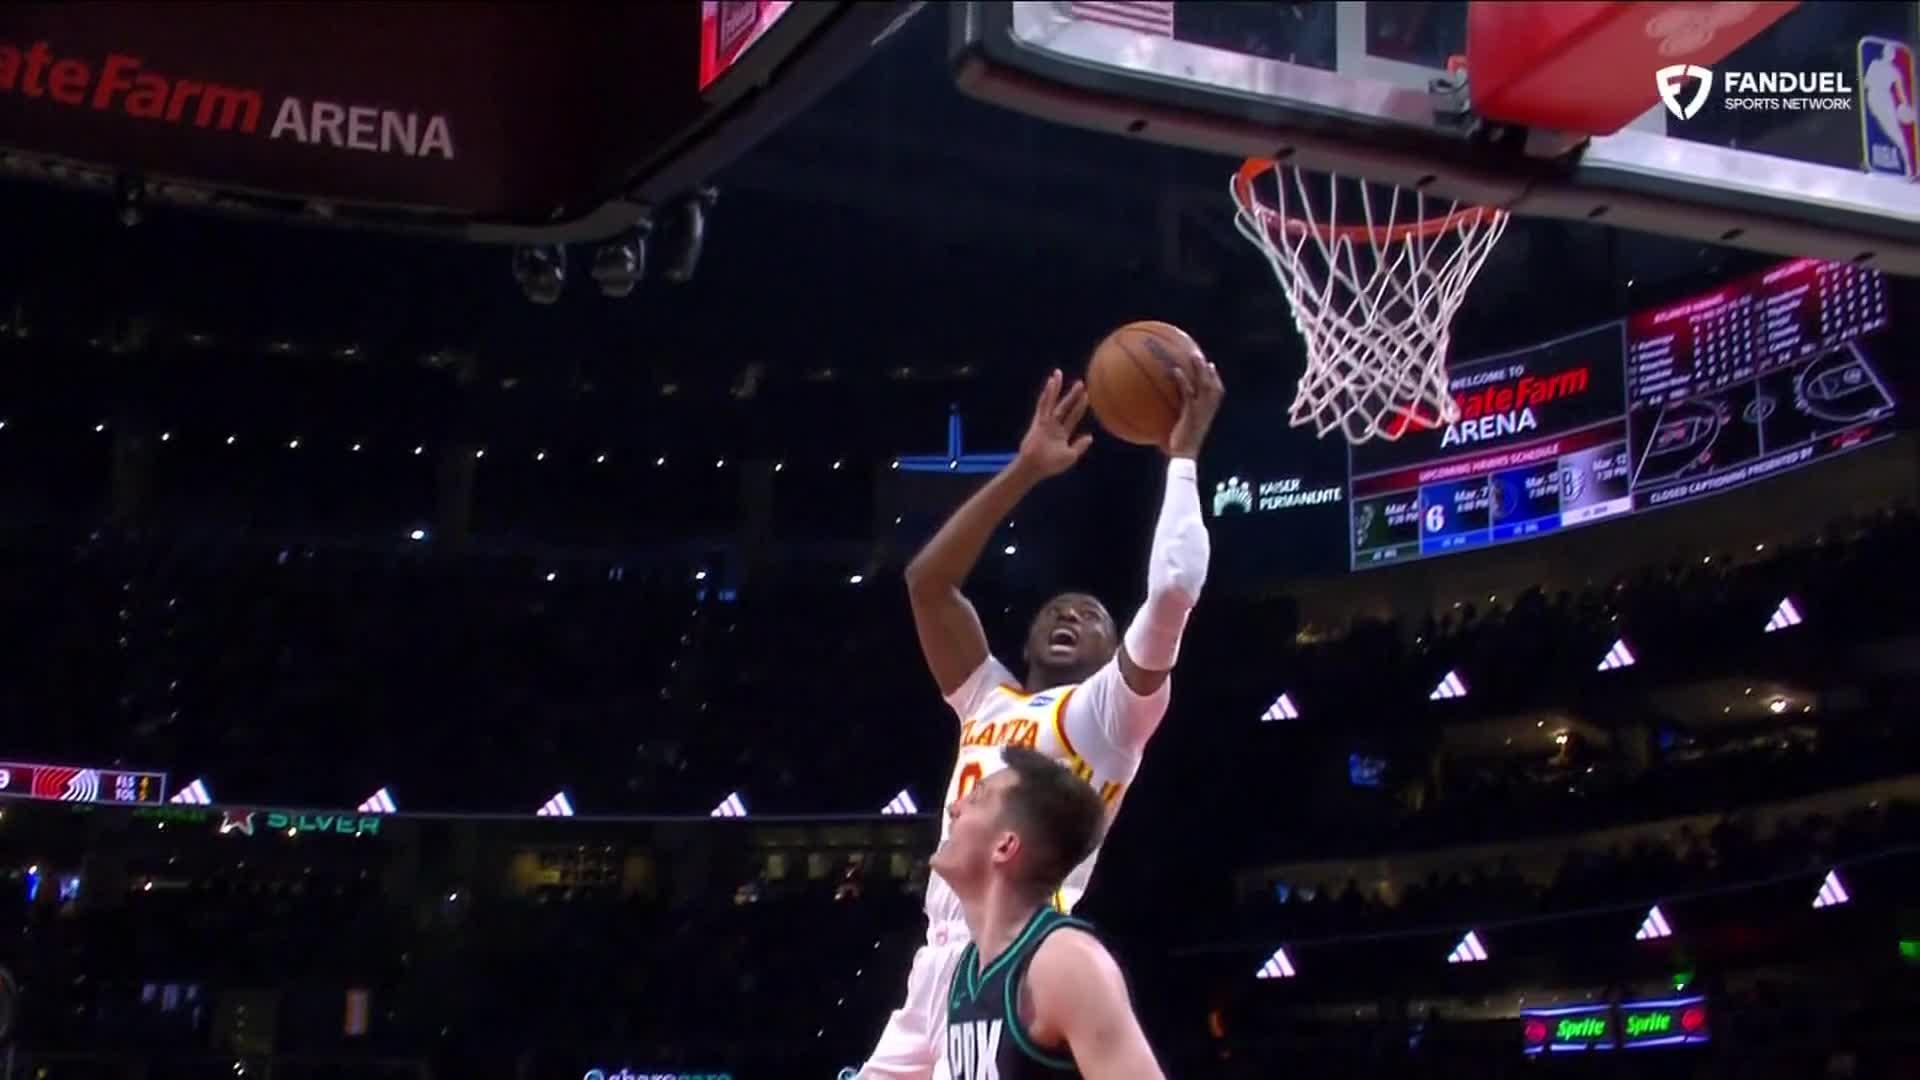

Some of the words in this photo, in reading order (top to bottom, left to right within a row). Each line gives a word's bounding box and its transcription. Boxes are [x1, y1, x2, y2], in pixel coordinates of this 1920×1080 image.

[270, 96, 455, 160] ARENA
[1451, 368, 1505, 390] WELCOME
[1509, 364, 1525, 378] TO
[1440, 407, 1538, 448] ARENA
[1259, 479, 1301, 496] KAISER
[1259, 487, 1342, 511] PERMANENTE
[1650, 486, 1688, 504] CLOSED
[1556, 1017, 1605, 1041] Sprite
[1626, 1011, 1671, 1036] Sprite
